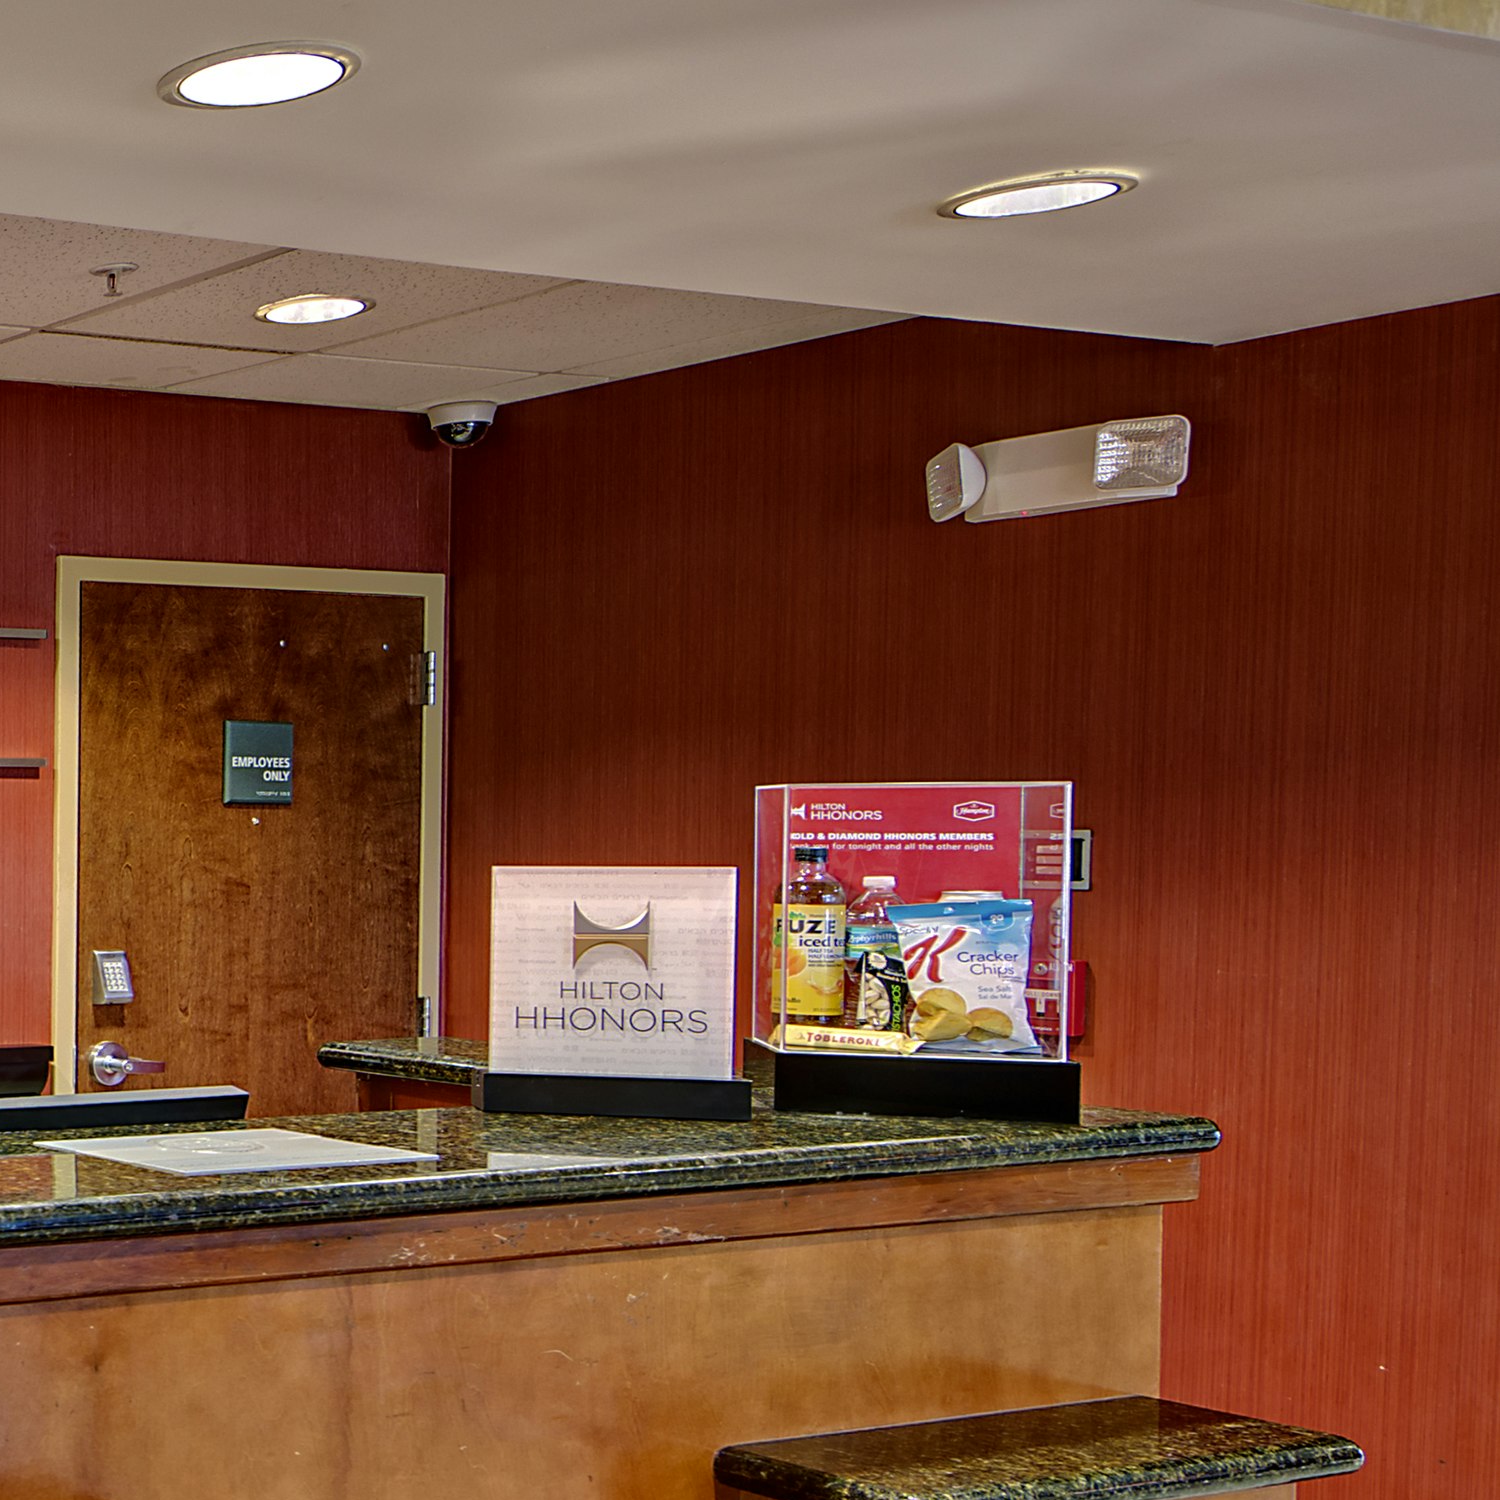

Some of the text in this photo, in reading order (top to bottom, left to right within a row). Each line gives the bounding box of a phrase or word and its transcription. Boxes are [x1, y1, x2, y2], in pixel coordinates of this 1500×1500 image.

[232, 756, 290, 768] EMPLOYEES
[263, 770, 290, 781] ONLY
[811, 803, 846, 811] HILTON
[811, 810, 883, 820] HHONORS
[817, 832, 826, 840] &
[828, 832, 881, 840] DIAMOND
[884, 832, 937, 840] HHONORS
[939, 832, 994, 840] MEMBERS
[833, 842, 845, 850] for
[848, 843, 881, 852] tonight
[776, 918, 836, 934] FUZE
[799, 935, 831, 947] iced
[903, 926, 967, 984] K
[957, 949, 1019, 963] Cracker
[969, 963, 1015, 978] Chips
[560, 981, 664, 1001] HILTON
[978, 985, 994, 993] Sea
[515, 1006, 708, 1034] HHONORS
